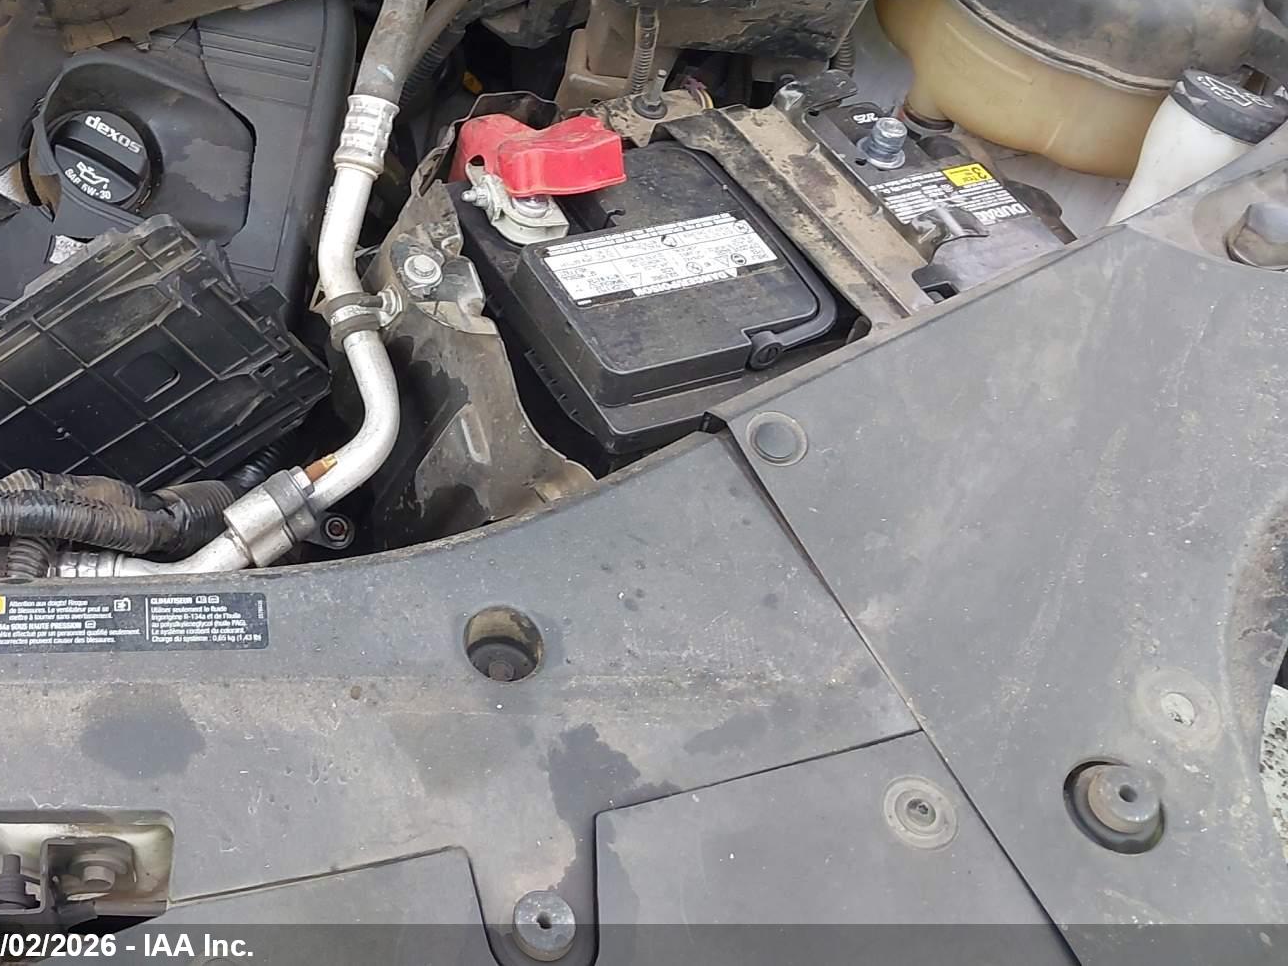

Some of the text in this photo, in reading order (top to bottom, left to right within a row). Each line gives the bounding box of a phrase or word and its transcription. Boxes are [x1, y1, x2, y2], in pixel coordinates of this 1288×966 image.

[85, 116, 143, 153] dexos
[971, 166, 987, 179] 3
[81, 183, 111, 199] 5W-30
